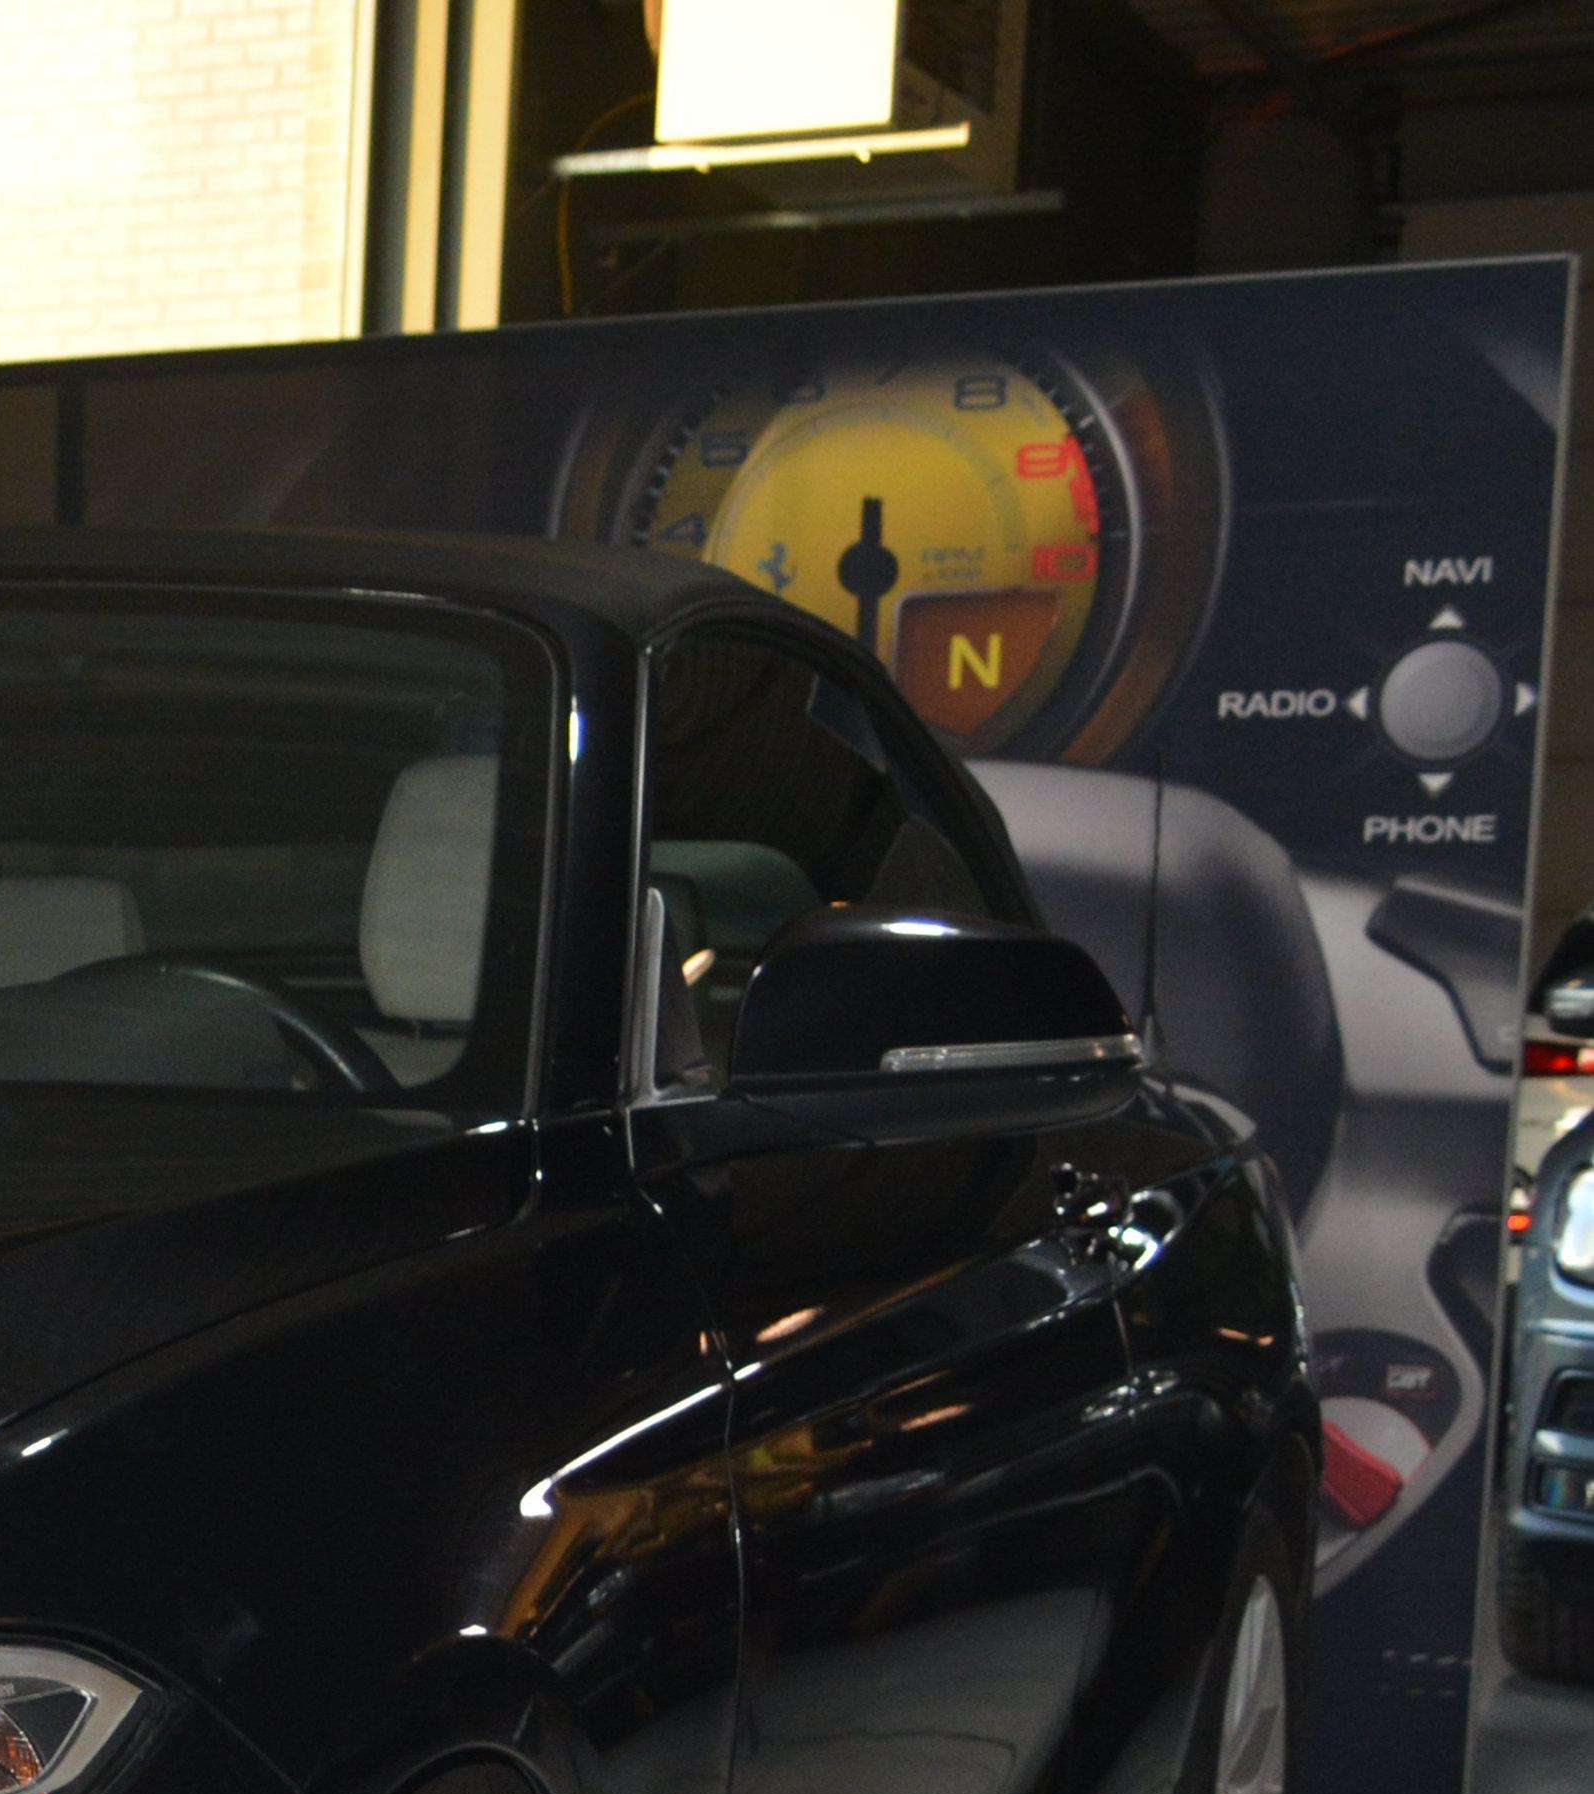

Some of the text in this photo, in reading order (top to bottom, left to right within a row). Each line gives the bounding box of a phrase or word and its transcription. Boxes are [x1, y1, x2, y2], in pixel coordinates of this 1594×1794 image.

[954, 373, 1008, 411] 8
[1404, 556, 1493, 586] NAVI
[949, 632, 1003, 690] N
[1218, 689, 1336, 719] RADIO
[1363, 814, 1498, 843] PHONE
